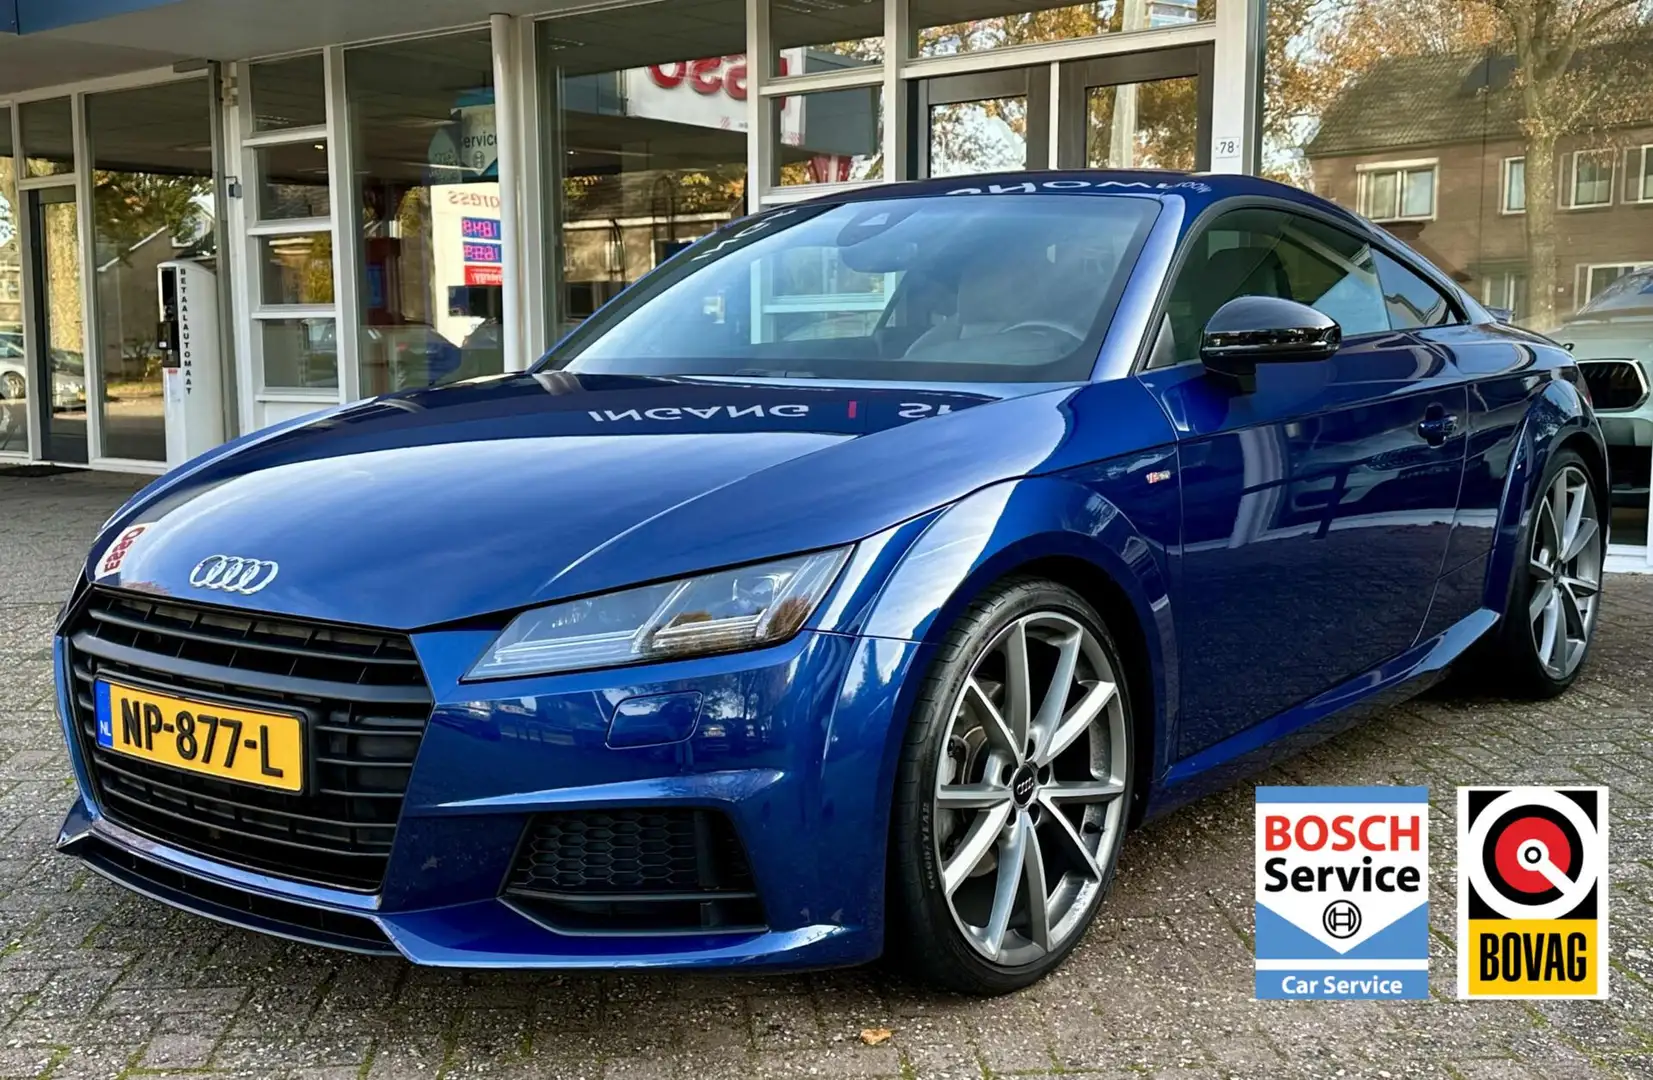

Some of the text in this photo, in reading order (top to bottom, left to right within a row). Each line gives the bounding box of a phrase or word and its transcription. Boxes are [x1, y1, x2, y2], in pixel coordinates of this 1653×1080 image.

[1220, 141, 1235, 154] 78
[179, 268, 192, 395] BETAALAUTOMAAT
[100, 721, 111, 737] NL
[121, 697, 283, 778] NP-877-L
